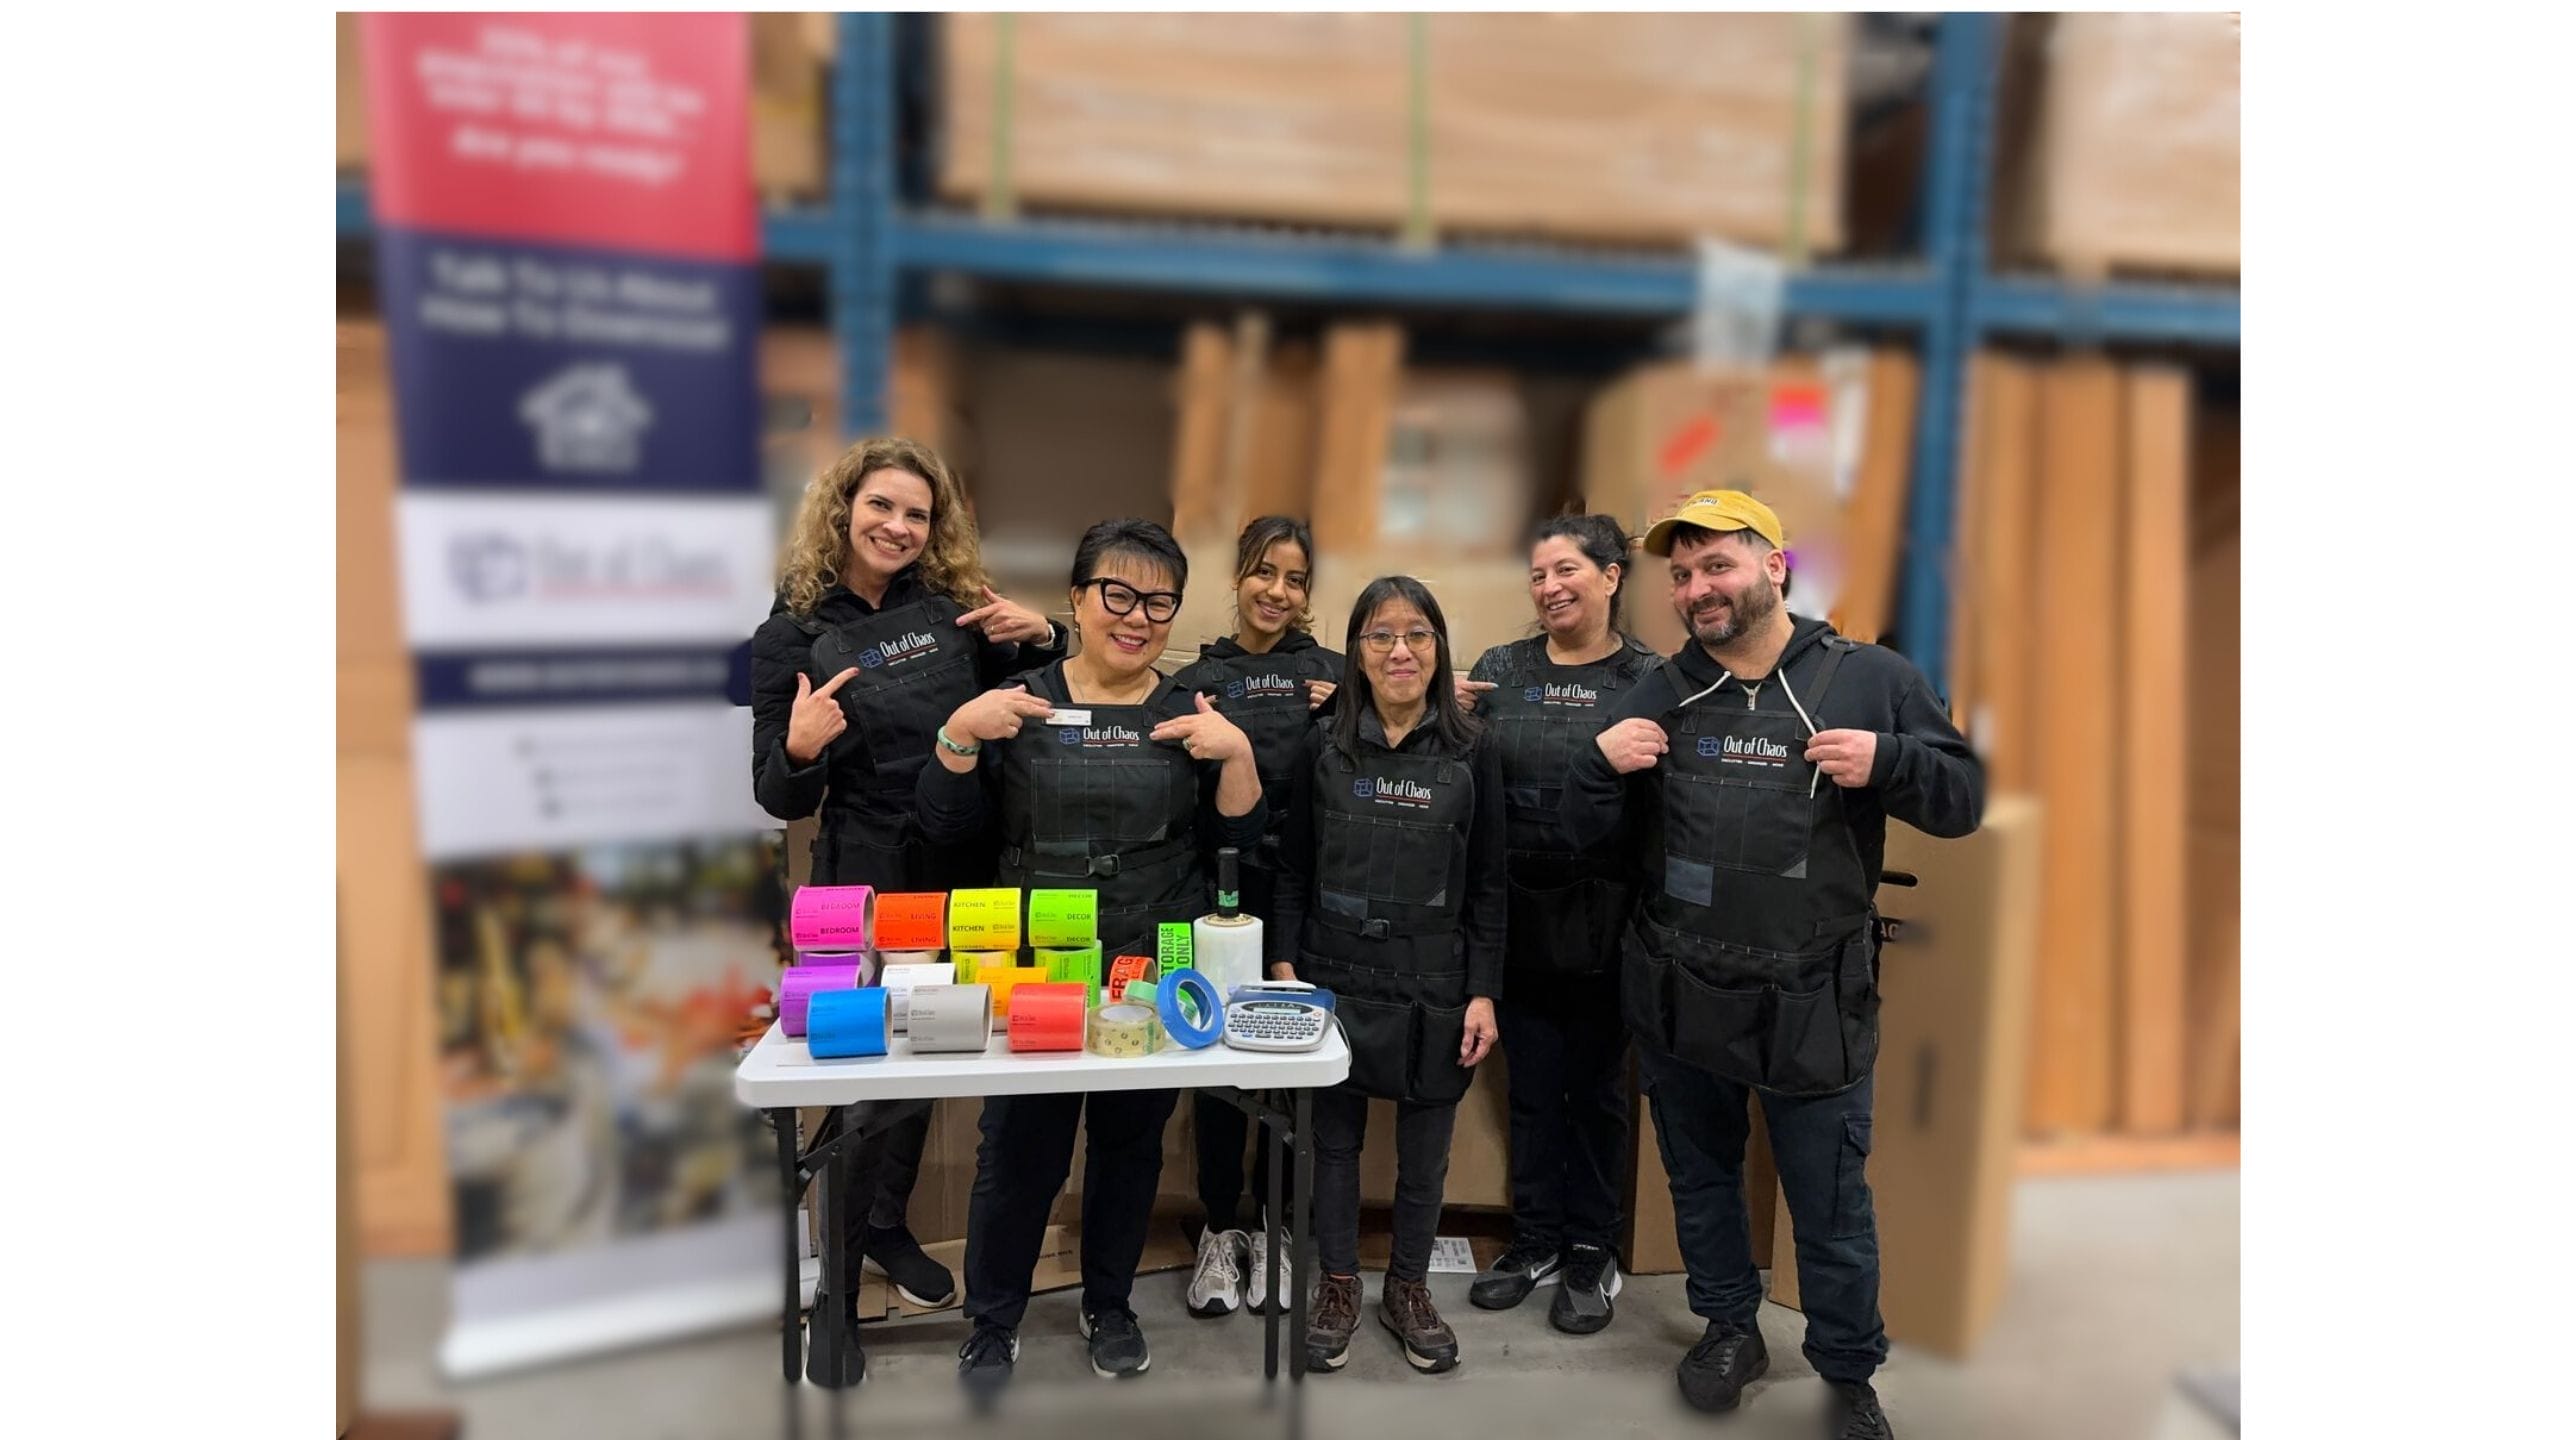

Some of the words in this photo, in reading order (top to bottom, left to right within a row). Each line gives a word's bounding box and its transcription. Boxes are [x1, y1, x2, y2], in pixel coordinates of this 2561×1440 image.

[880, 640, 901, 658] Out
[899, 634, 911, 652] of
[907, 632, 936, 648] Chaos
[1246, 676, 1261, 691] Out
[1261, 674, 1270, 688] of
[1271, 673, 1295, 689] Chaos
[1545, 683, 1561, 697] Out
[1561, 683, 1572, 698] of
[1572, 683, 1598, 700] Chaos
[1082, 726, 1101, 741] Out
[1101, 726, 1113, 741] of
[1112, 725, 1141, 741] Chaos
[1723, 735, 1743, 754] Out
[1743, 736, 1757, 754] of
[1757, 737, 1789, 758] Chaos
[1376, 776, 1393, 795] Out
[1394, 778, 1405, 797] of
[1405, 780, 1432, 800] Chaos
[821, 903, 860, 911] BEDROOM
[820, 926, 859, 935] BEDROOM
[1176, 935, 1190, 964] ONLY
